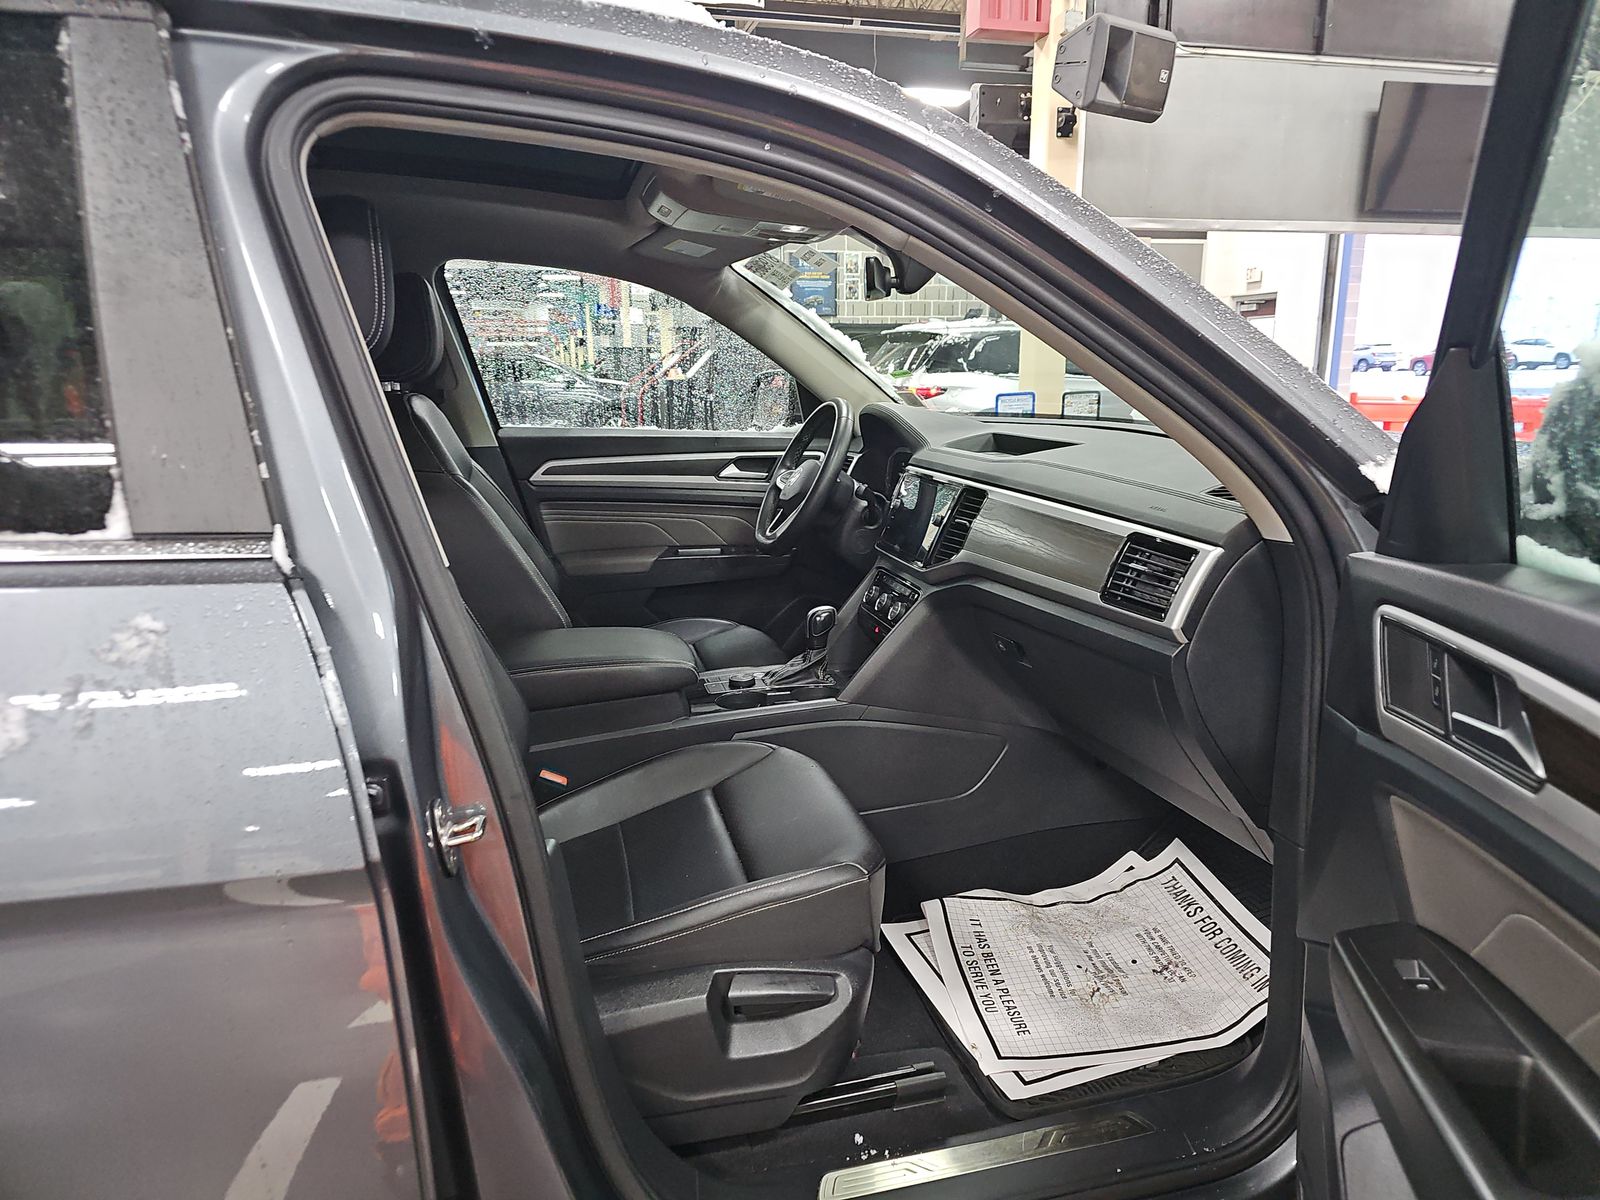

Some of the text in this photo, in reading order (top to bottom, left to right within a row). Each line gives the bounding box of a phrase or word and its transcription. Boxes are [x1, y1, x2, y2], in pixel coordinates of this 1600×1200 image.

[1135, 932, 1147, 944] WITH
[1143, 944, 1156, 956] THIS
[1157, 933, 1170, 946] HAVE
[1166, 945, 1181, 960] TRIED
[1161, 875, 1270, 993] THANKS FOR COMING IN
[960, 943, 998, 1014] TO SERVE YOU
[969, 918, 1031, 1037] IT HAS BEEN A PLEASURE
[1026, 945, 1034, 953] are
[1030, 955, 1044, 973] always
[1036, 943, 1067, 1000] improving our service
[1053, 955, 1072, 987] suggestions
[1069, 989, 1077, 997] for
